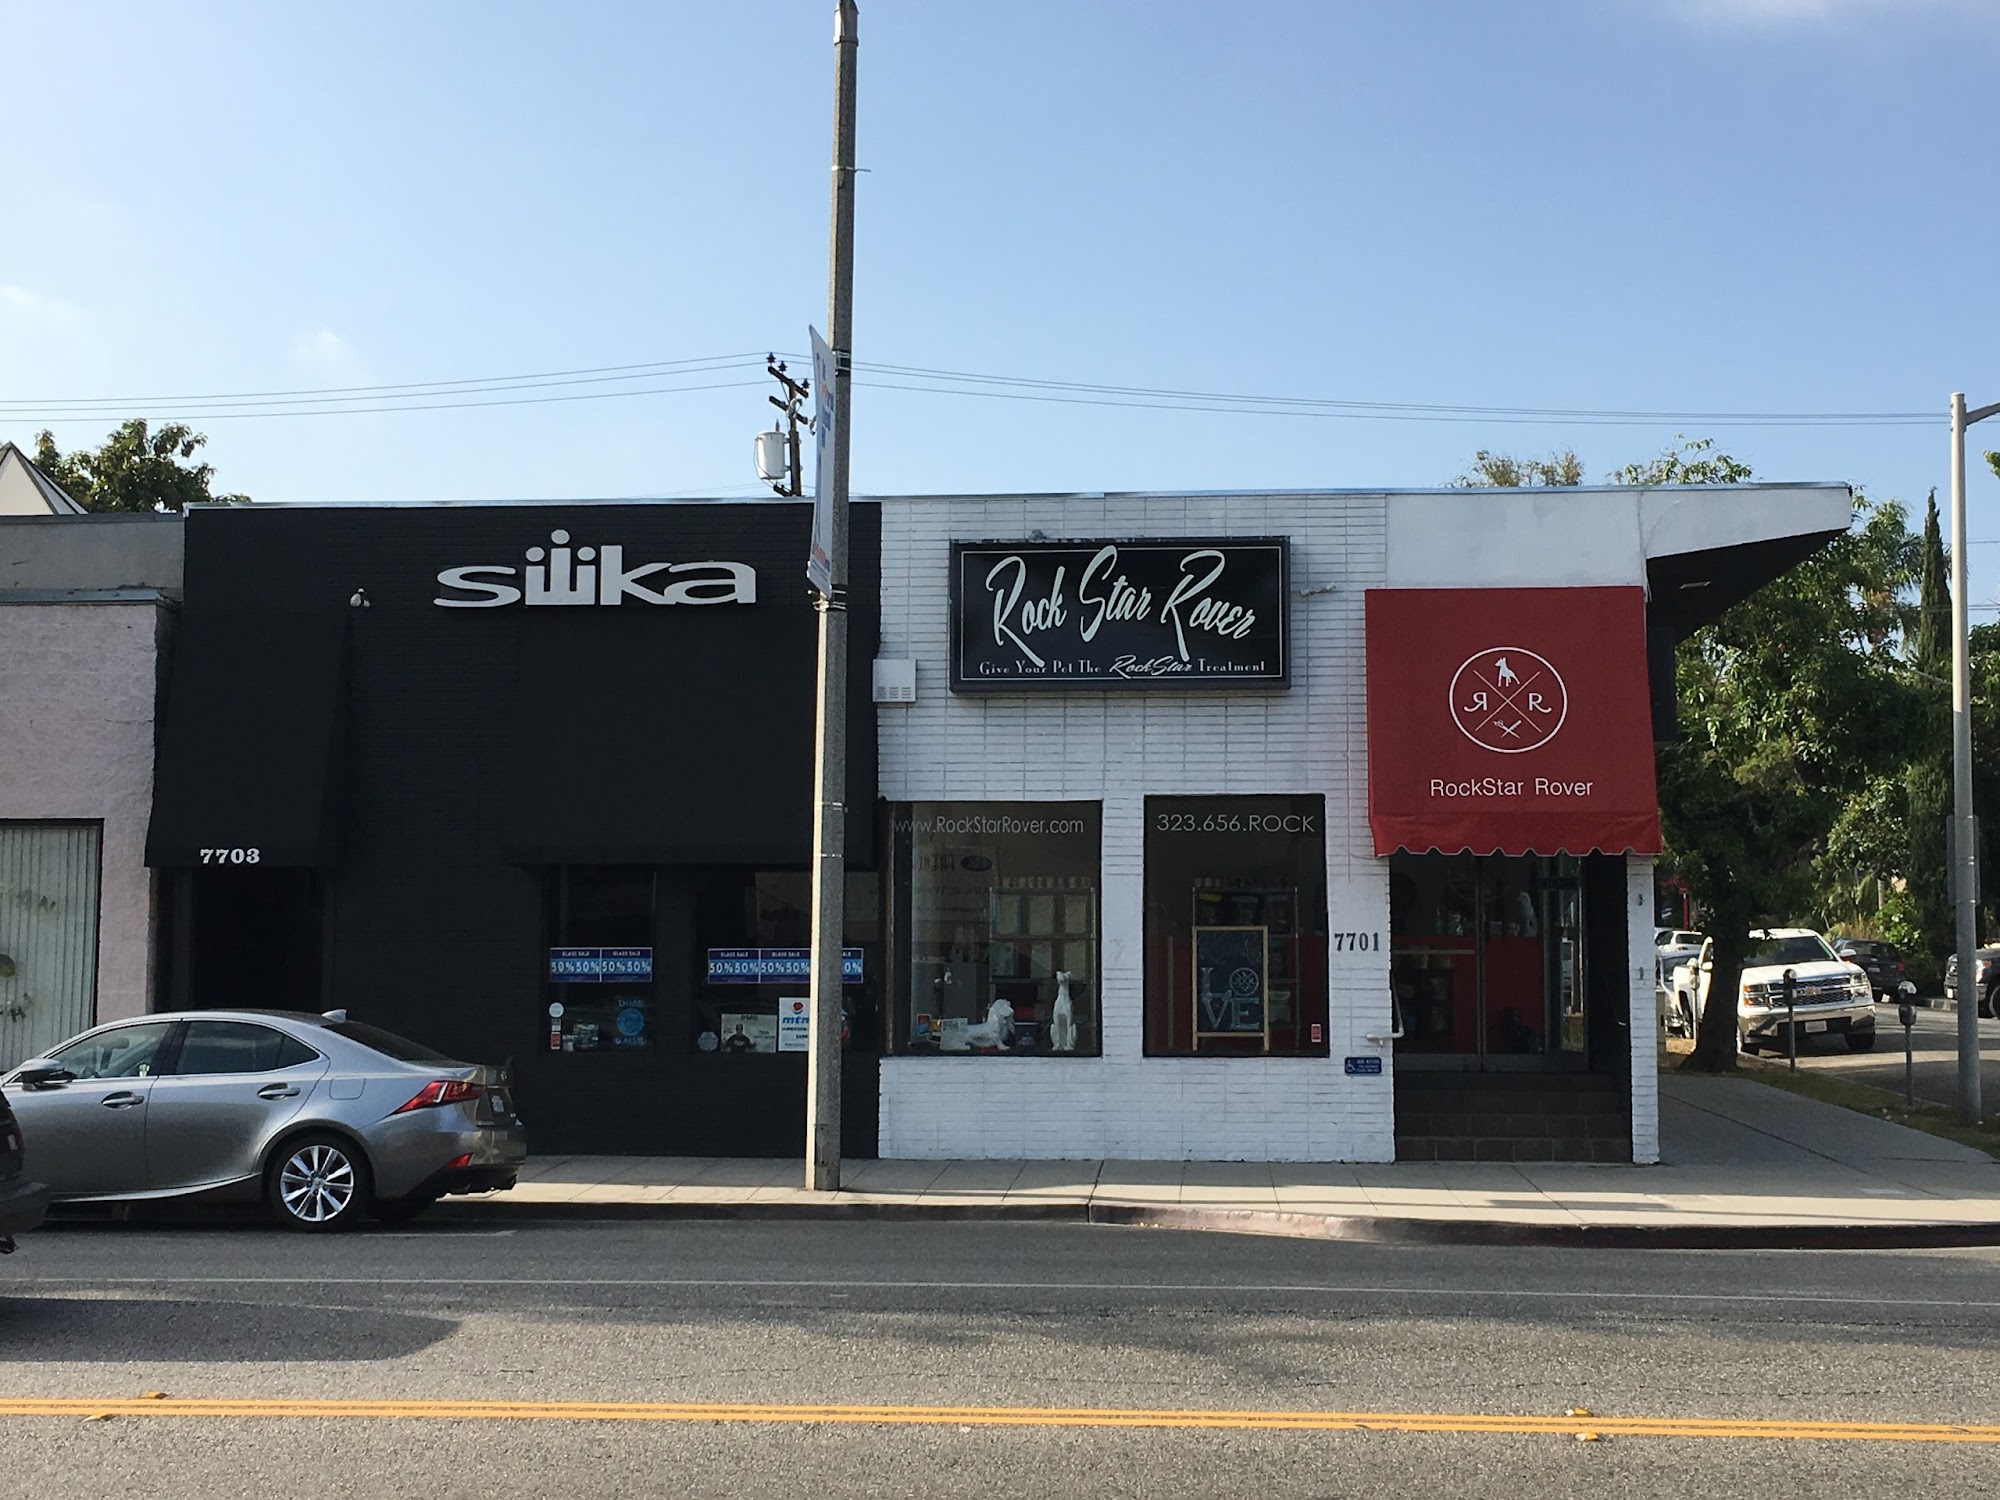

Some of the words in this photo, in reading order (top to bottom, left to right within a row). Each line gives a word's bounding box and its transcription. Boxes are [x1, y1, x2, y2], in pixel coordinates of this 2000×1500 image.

[985, 555, 1068, 668] Rock
[1078, 544, 1152, 642] Star
[1160, 549, 1256, 662] Rover
[979, 661, 1010, 675] Give
[1015, 659, 1047, 674] Your
[1053, 659, 1073, 674] Pet
[1078, 659, 1101, 674] The
[1108, 654, 1193, 679] RockStar
[1197, 658, 1266, 672] Treatment
[1430, 777, 1524, 797] RockStar
[1534, 777, 1594, 796] Rover
[892, 816, 1085, 836] www.RockStarRover.com
[1156, 813, 1316, 833] 323.656.ROCK
[200, 848, 260, 864] 7703
[1334, 932, 1379, 951] 7701
